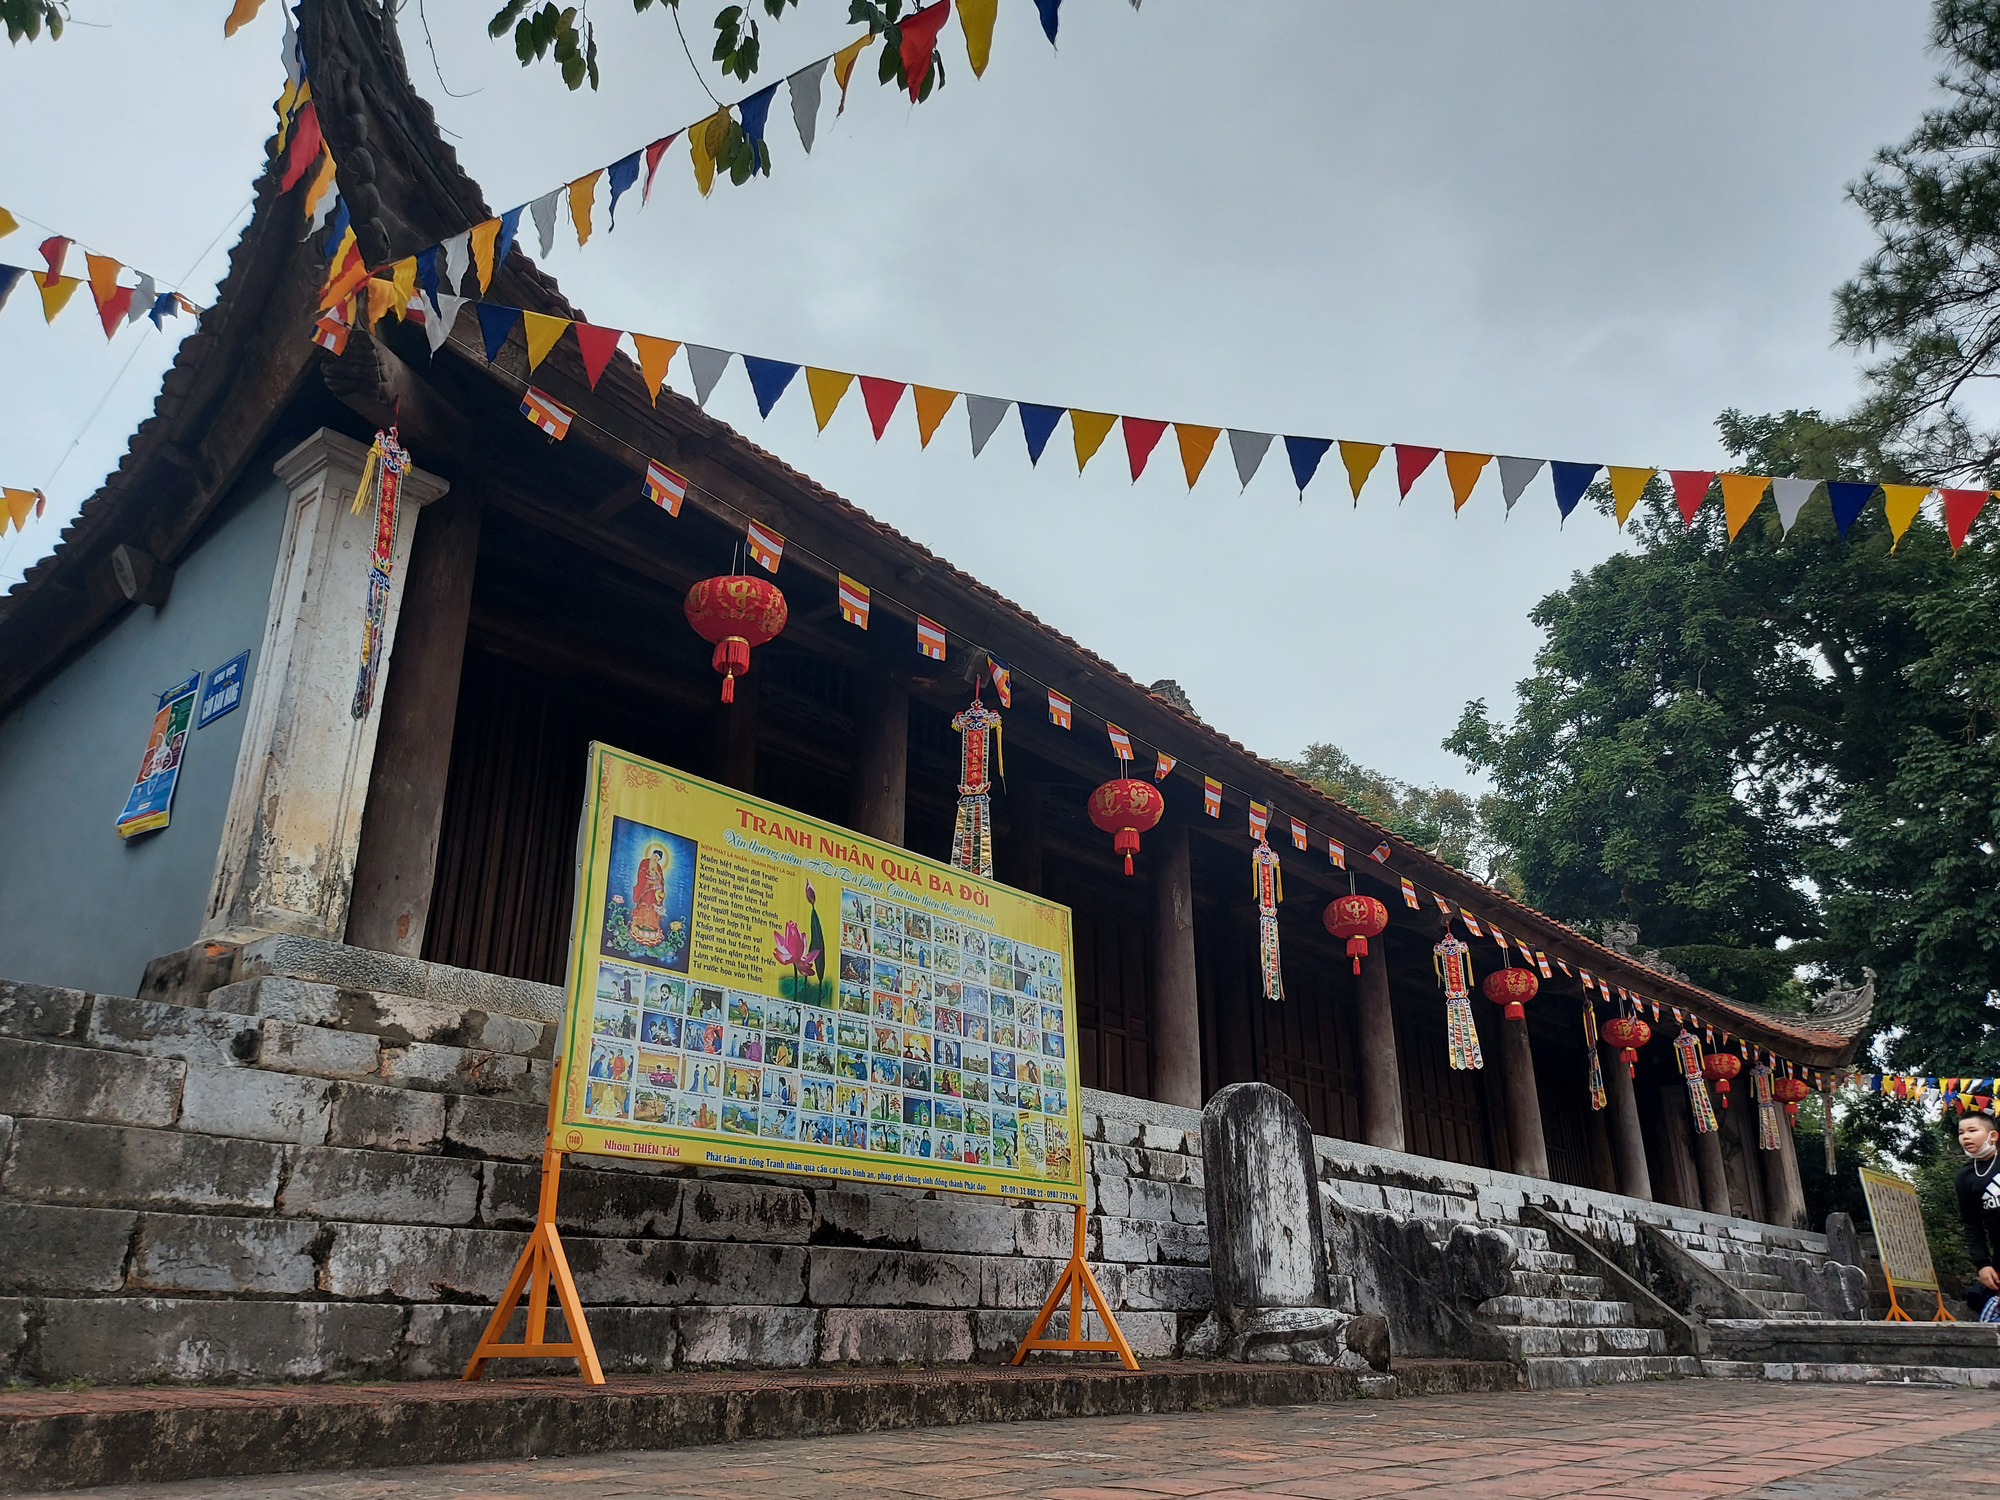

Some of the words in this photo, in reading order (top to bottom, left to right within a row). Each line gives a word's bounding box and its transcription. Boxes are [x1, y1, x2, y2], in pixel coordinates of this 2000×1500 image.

[724, 828, 745, 849] Xin
[780, 852, 802, 866] niệm
[735, 807, 811, 849] TRANH
[819, 836, 874, 870] NHÂN
[880, 858, 921, 886] QUẢ
[928, 874, 952, 895] BA
[959, 884, 988, 907] ĐỜI
[568, 1135, 580, 1145] 1140
[604, 1139, 630, 1152] Nhóm
[633, 1142, 659, 1156] THIỆN
[661, 1145, 680, 1157] TÂM
[706, 1151, 722, 1162] Phát
[724, 1154, 736, 1164] tâm
[738, 1155, 747, 1165] ấn
[748, 1156, 764, 1168] tống
[765, 1158, 784, 1169] Tranh
[786, 1161, 802, 1171] nhân
